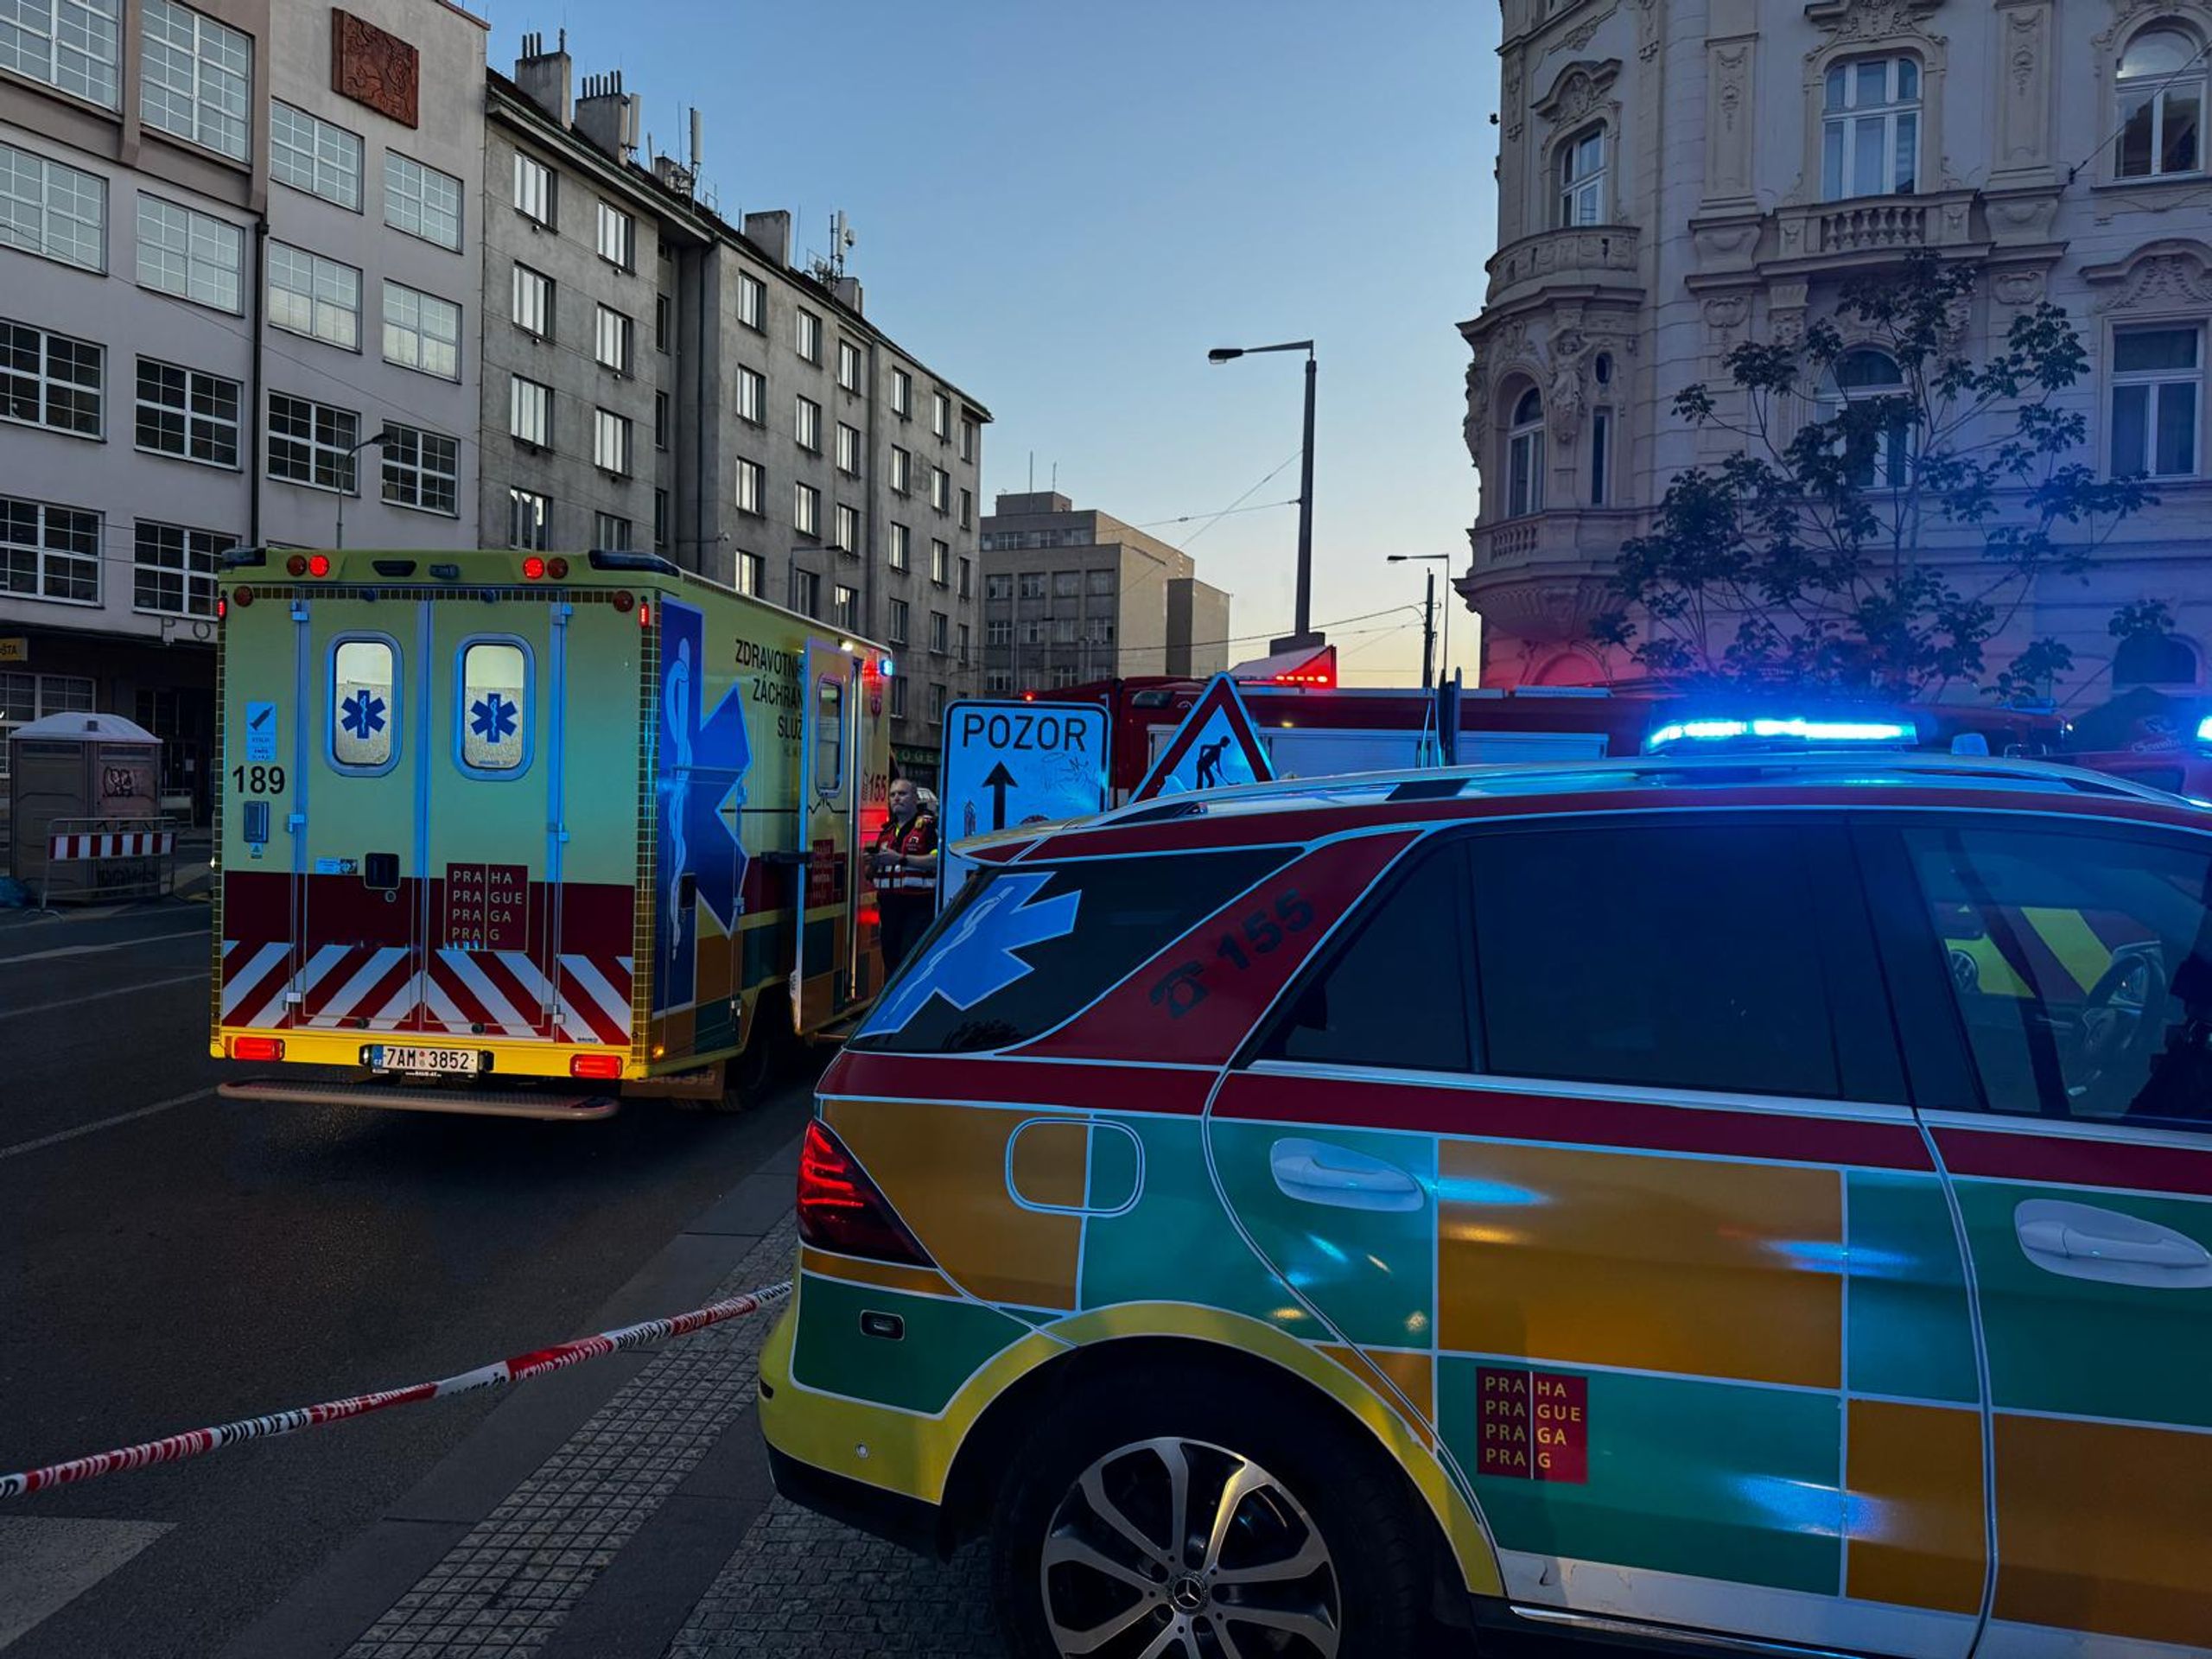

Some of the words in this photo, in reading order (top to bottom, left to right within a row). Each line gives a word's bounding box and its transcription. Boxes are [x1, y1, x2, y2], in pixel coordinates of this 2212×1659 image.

[963, 714, 1087, 752] POZOR
[232, 766, 285, 794] 189
[869, 772, 887, 803] 155
[1217, 887, 1314, 970] 155
[387, 1048, 416, 1067] 7AM
[429, 1051, 469, 1070] 3852
